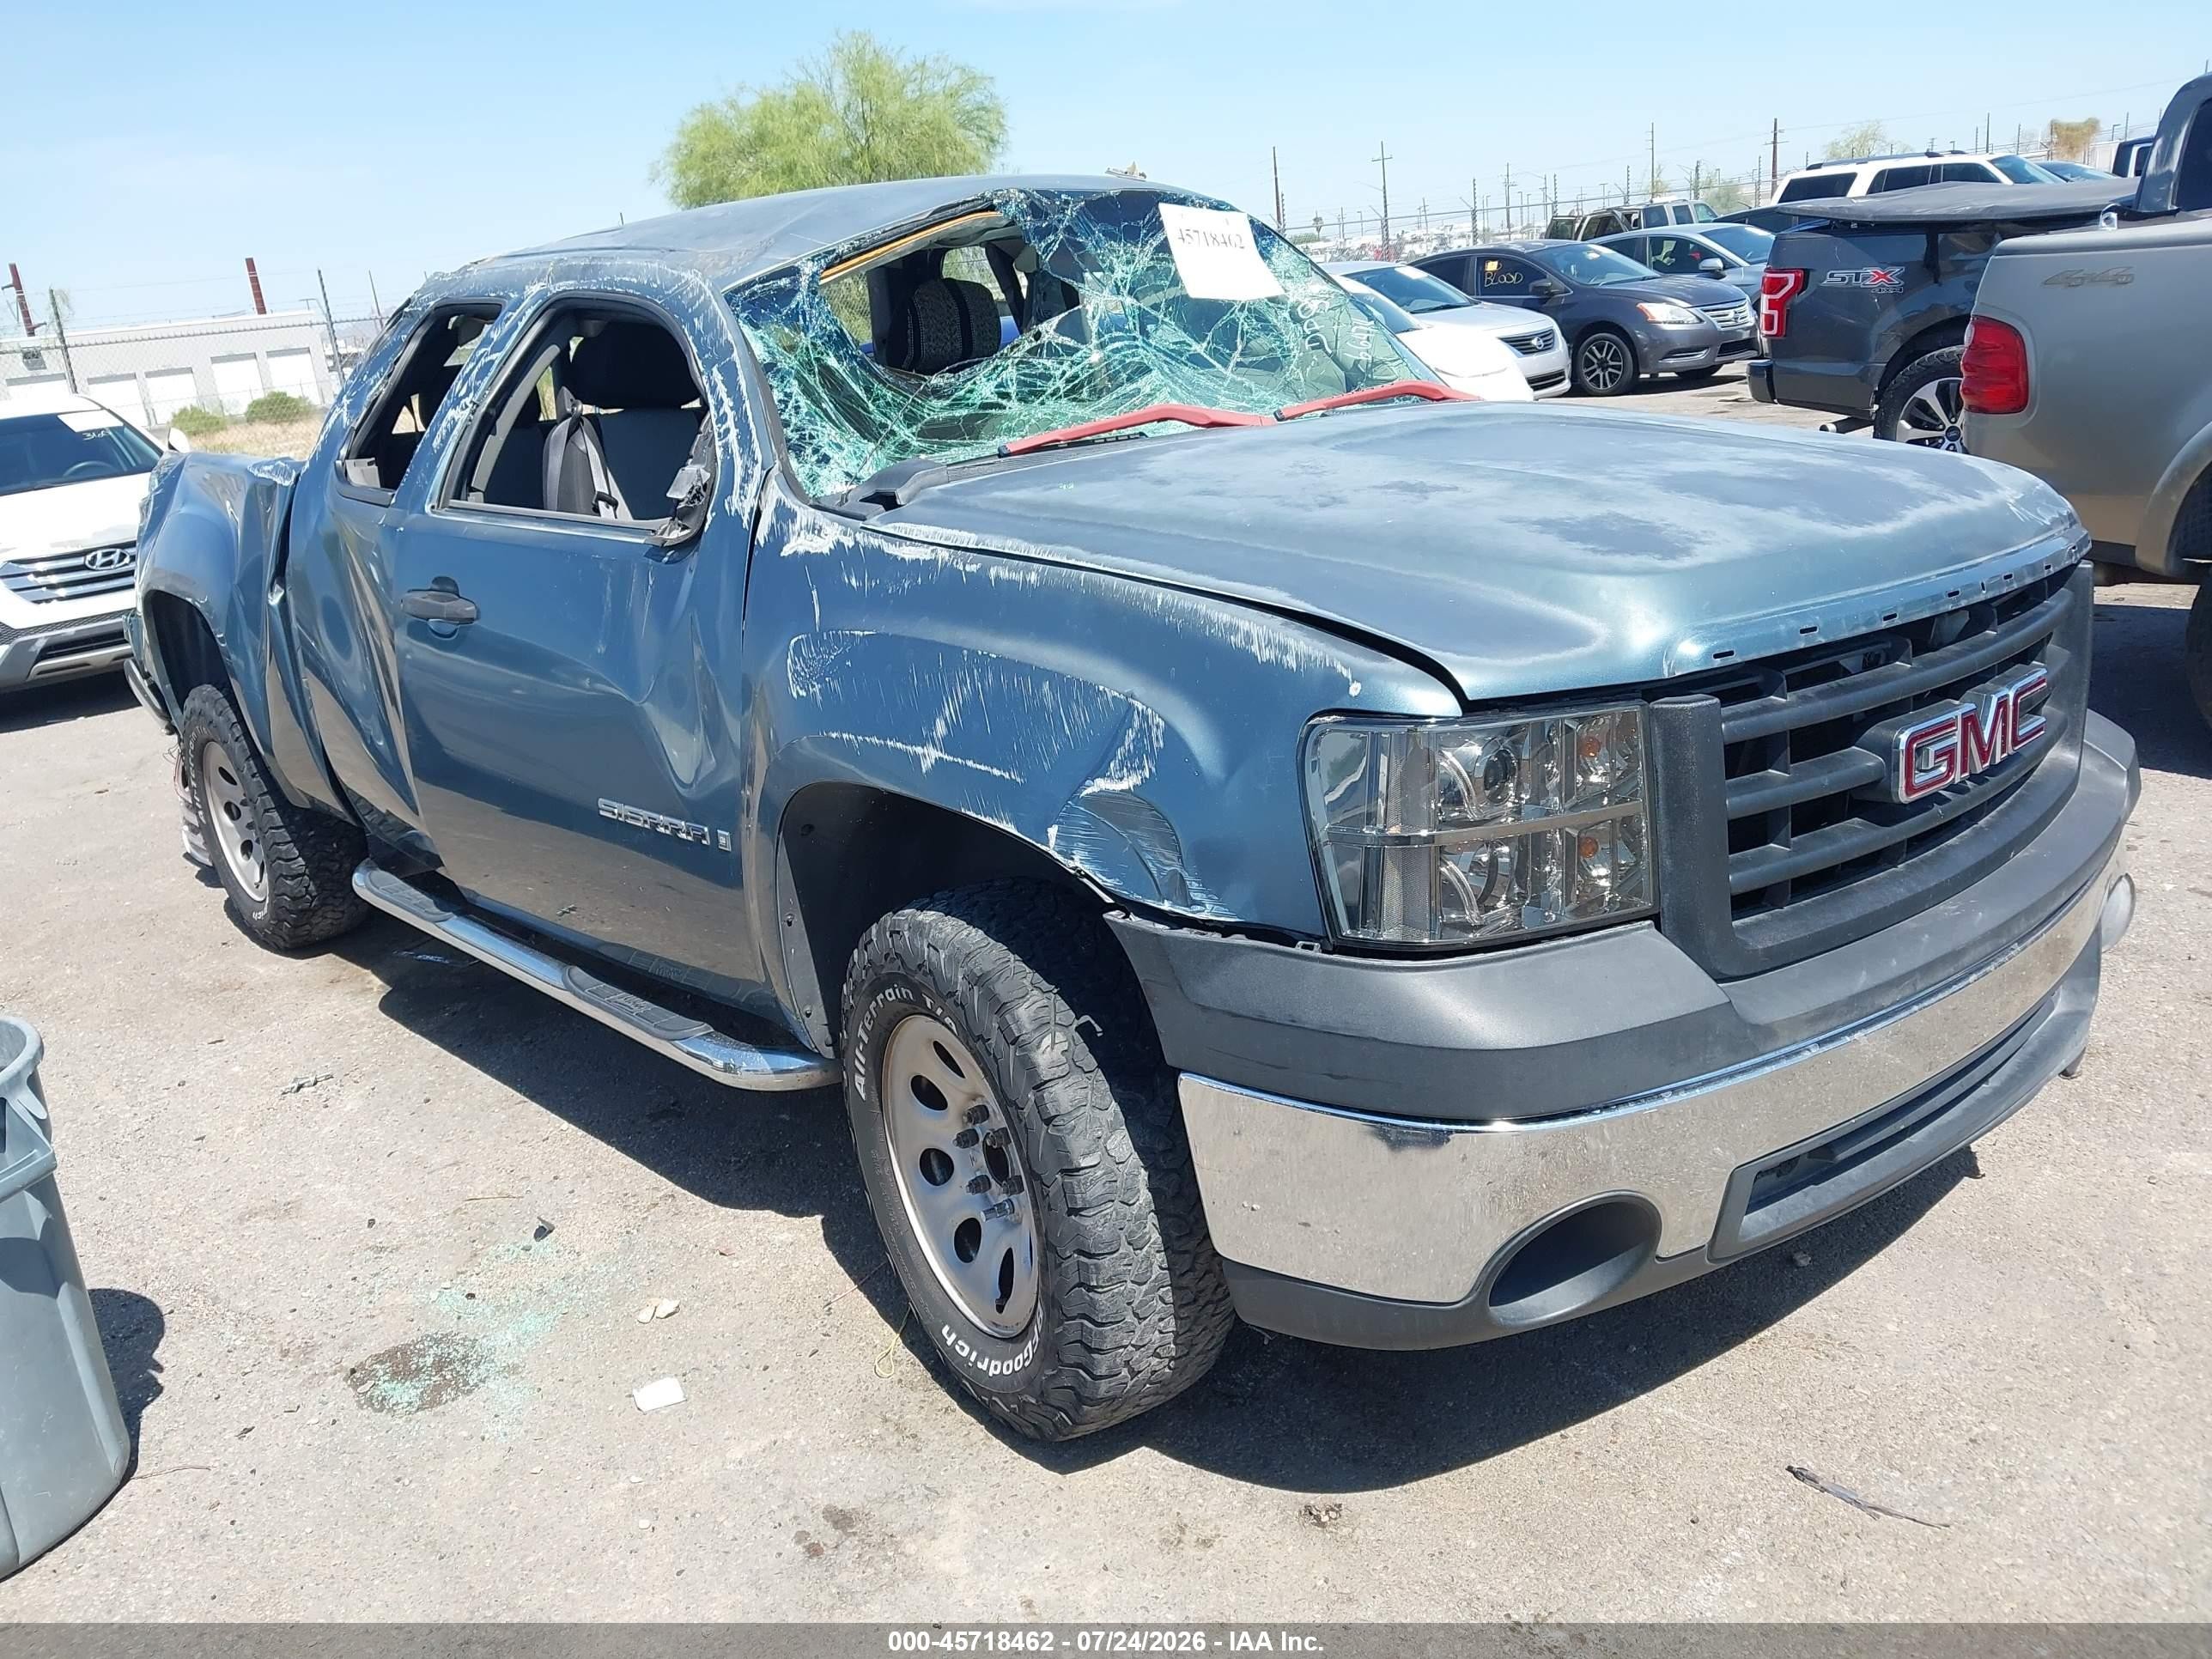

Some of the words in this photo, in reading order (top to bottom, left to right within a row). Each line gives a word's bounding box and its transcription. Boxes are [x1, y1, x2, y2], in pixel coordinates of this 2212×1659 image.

[1177, 228, 1245, 249] 45718462
[1485, 270, 1524, 288] BLOOD
[1820, 266, 1905, 288] STX
[1894, 667, 2048, 804] GMC
[598, 798, 711, 846] SIERRA
[854, 984, 915, 1102] All-Terrain
[941, 1301, 1044, 1377] BFGoodrich
